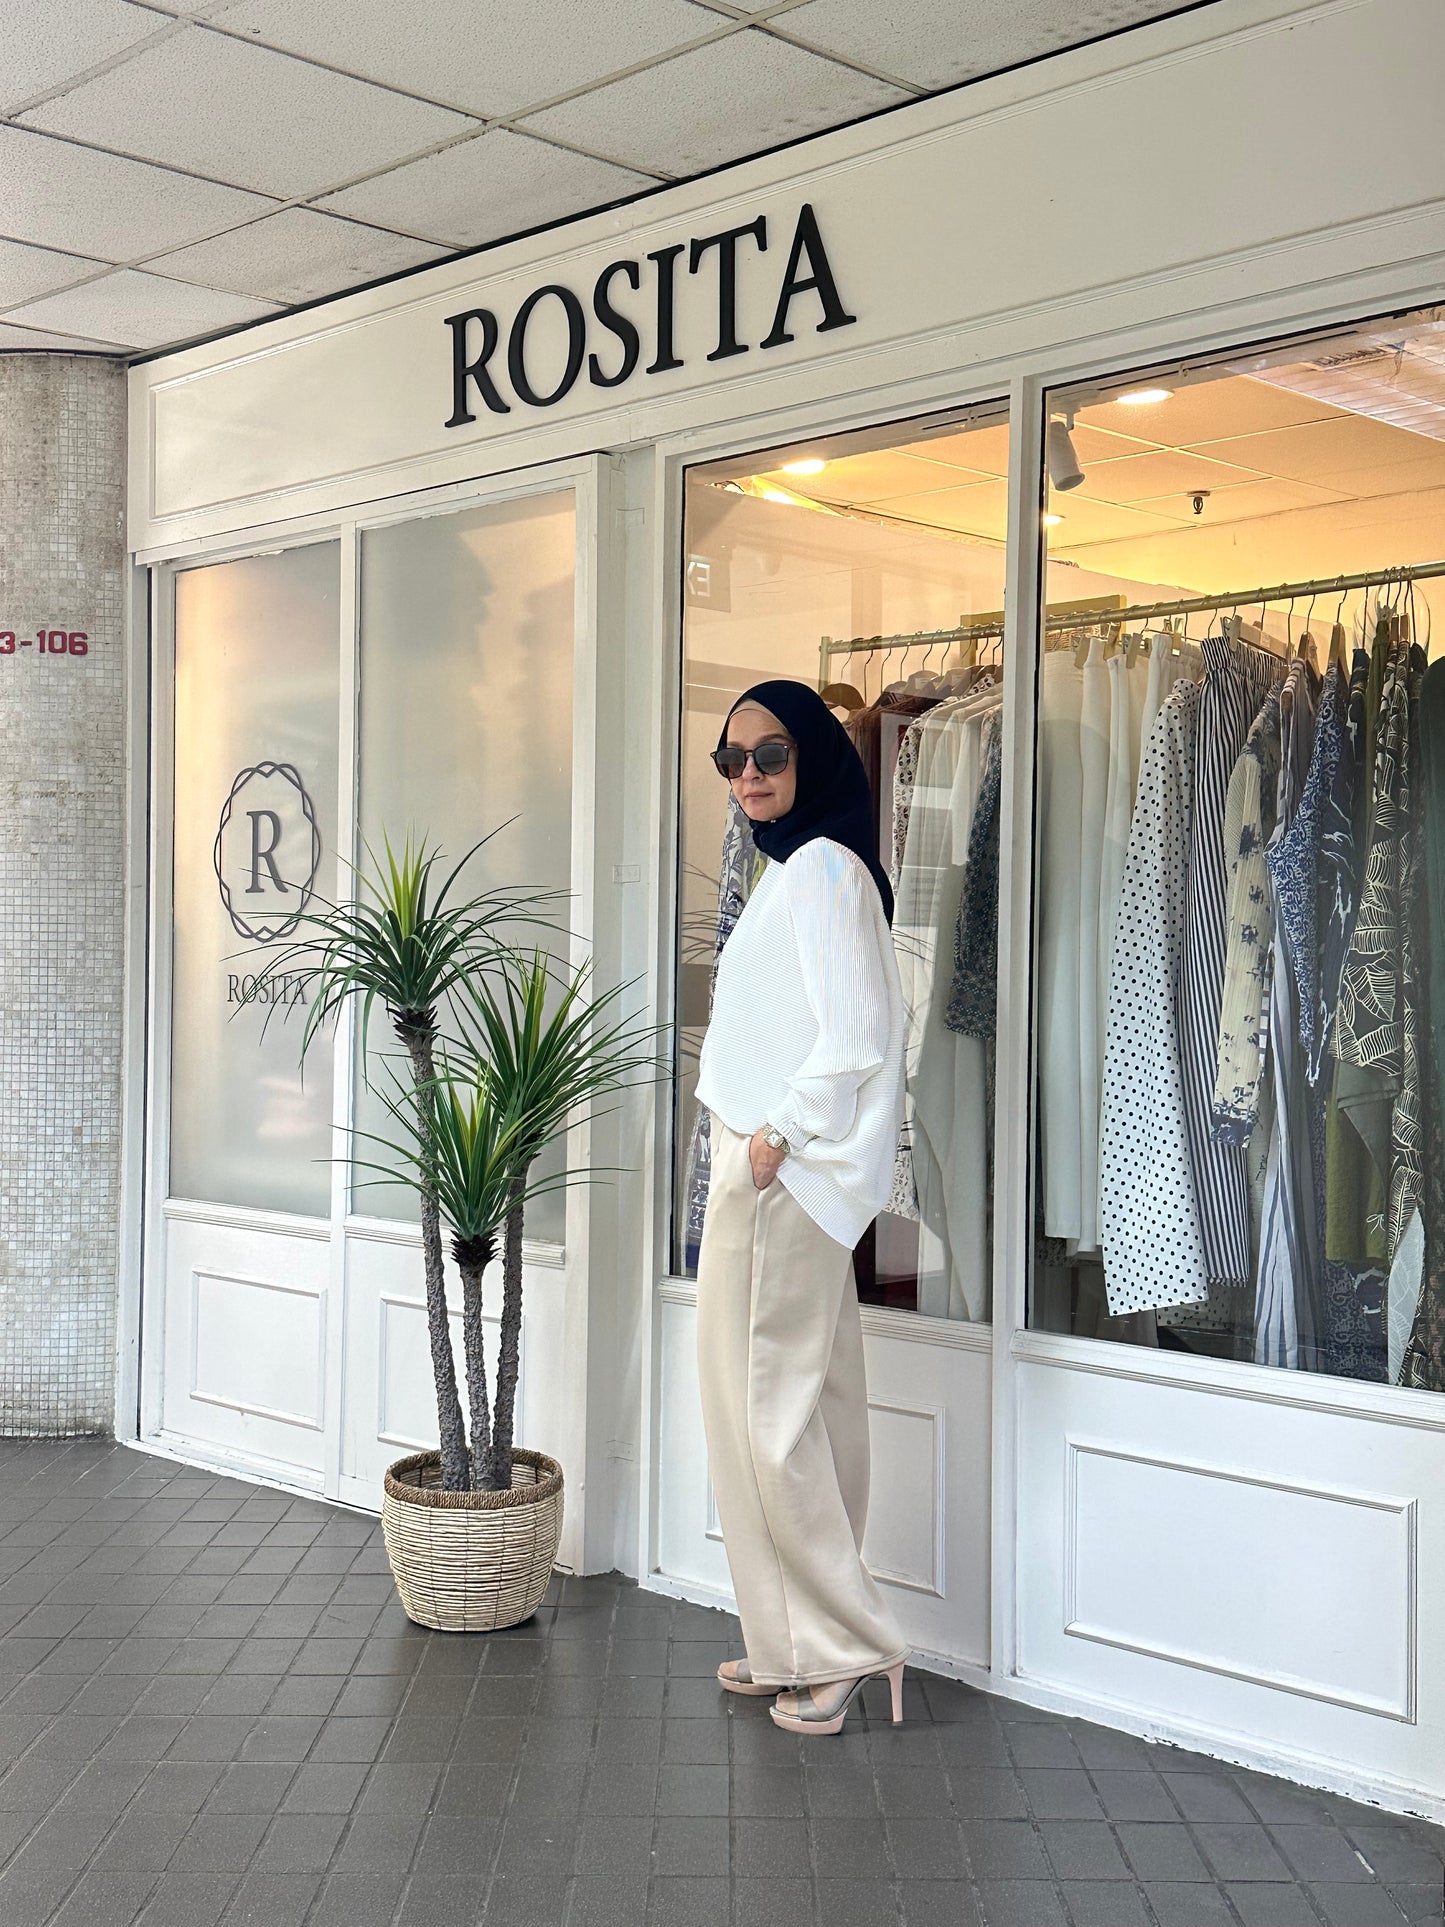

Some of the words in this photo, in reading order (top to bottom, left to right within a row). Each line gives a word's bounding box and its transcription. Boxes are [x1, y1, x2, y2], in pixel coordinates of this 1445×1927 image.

[444, 203, 857, 428] ROSITA
[0, 630, 88, 655] 3-106
[245, 810, 289, 893] R
[227, 974, 308, 1005] ROSITA
